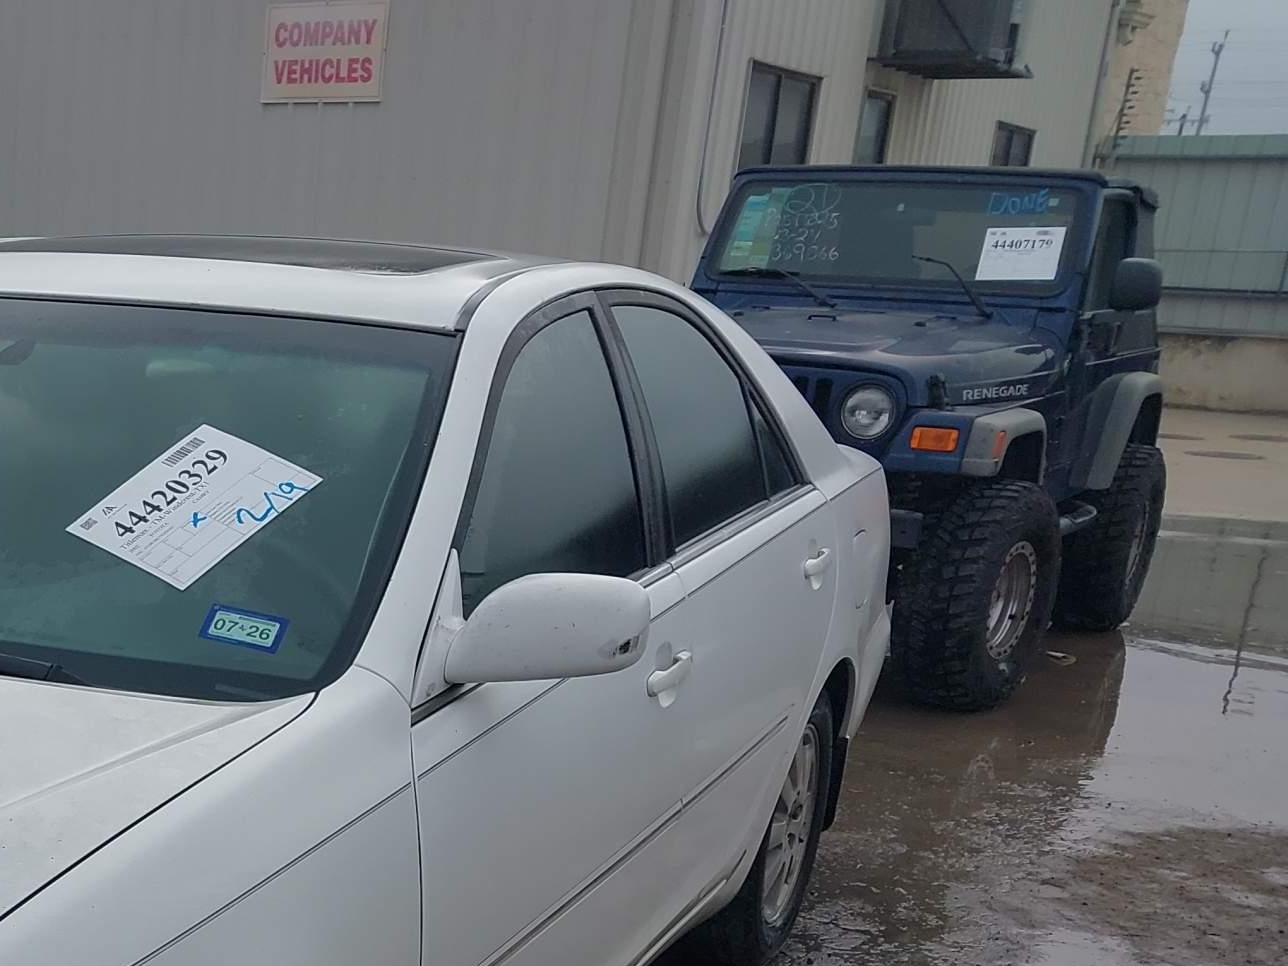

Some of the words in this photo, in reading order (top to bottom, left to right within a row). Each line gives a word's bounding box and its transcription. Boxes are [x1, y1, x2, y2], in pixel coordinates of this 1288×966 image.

[275, 18, 378, 48] COMPANY
[274, 57, 373, 85] VEHICLES
[991, 239, 1053, 249] 44407179
[962, 384, 1030, 401] RENEGADE
[114, 449, 228, 538] 44420329
[236, 481, 309, 525] 2/19
